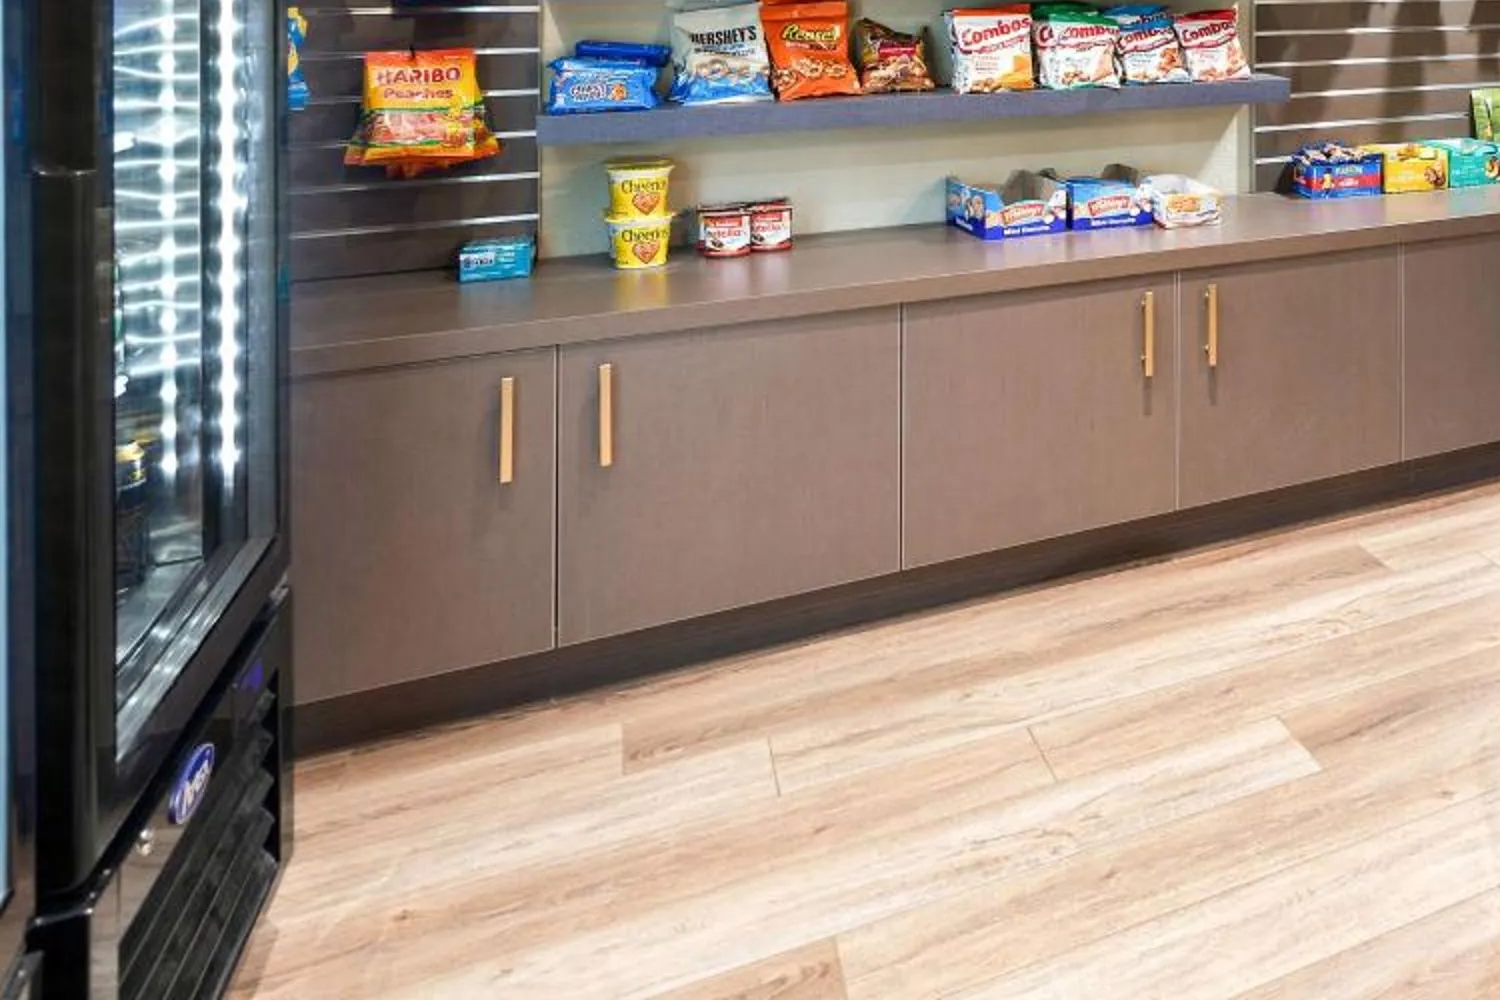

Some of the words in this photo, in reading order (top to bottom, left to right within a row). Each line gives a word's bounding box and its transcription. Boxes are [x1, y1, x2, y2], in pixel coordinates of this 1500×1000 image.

[691, 25, 757, 45] HERSHEY'S
[960, 17, 1032, 47] Combos
[1181, 21, 1236, 43] Combos
[376, 66, 461, 85] HARIBO
